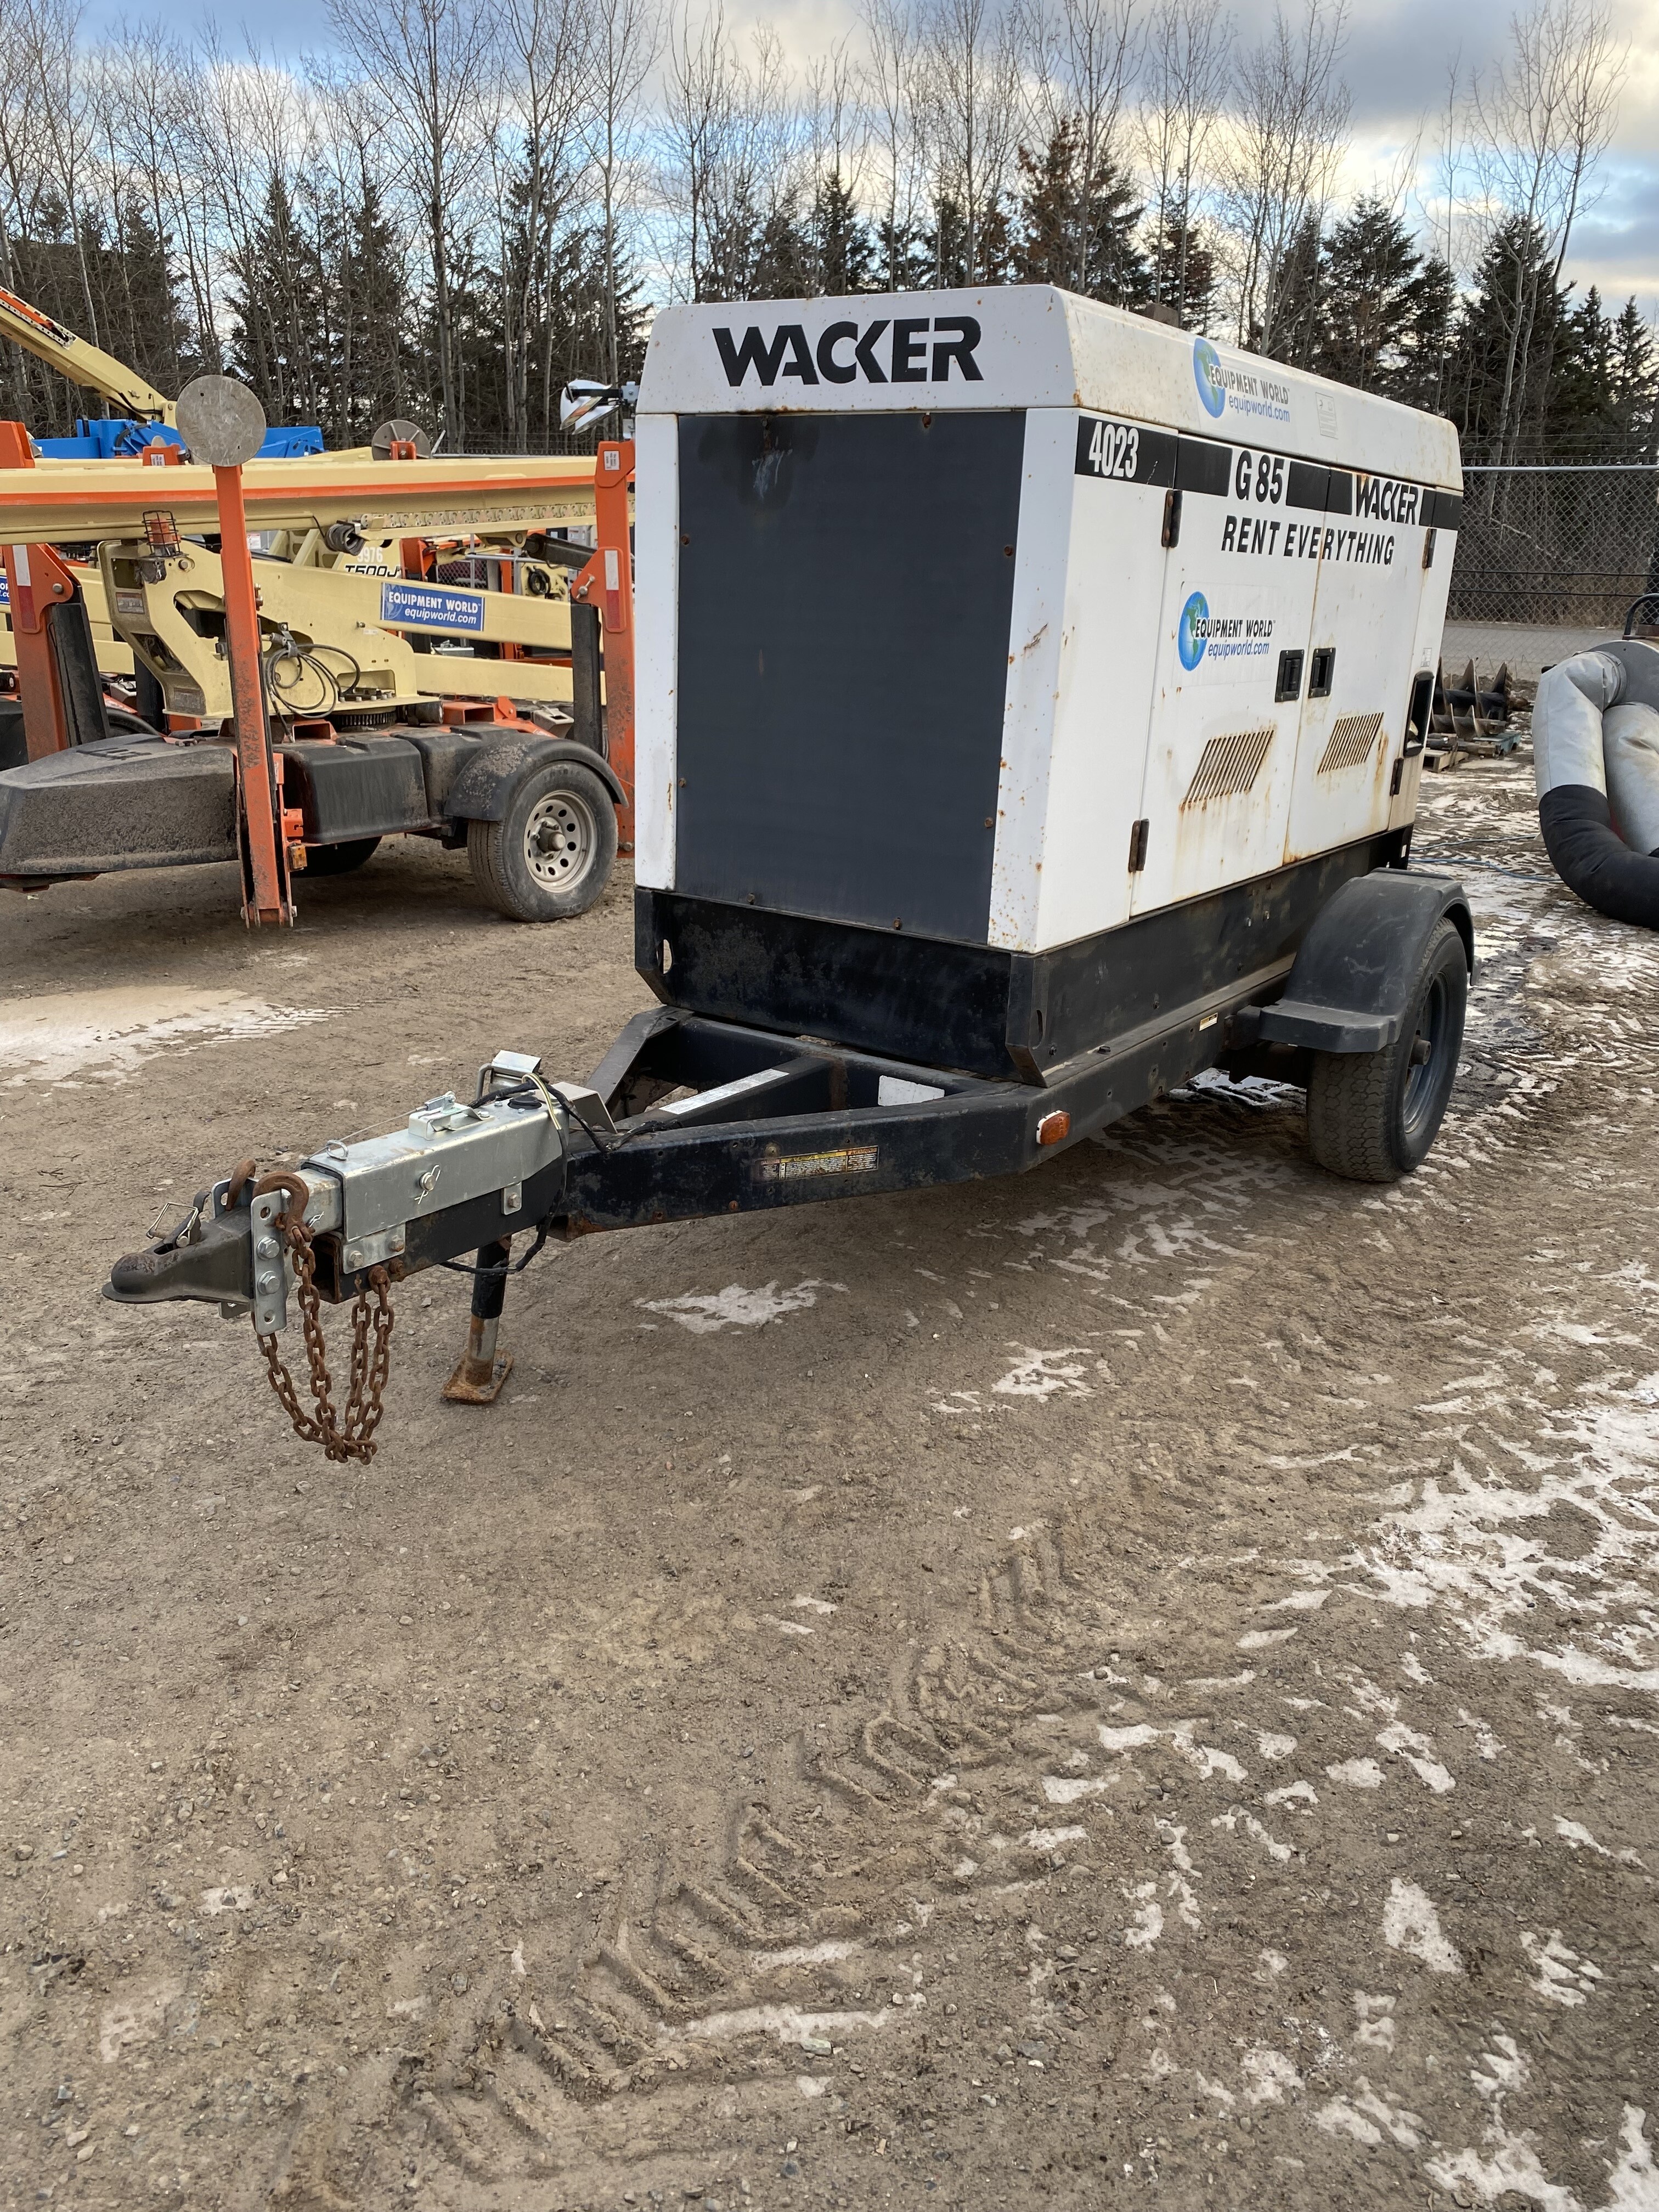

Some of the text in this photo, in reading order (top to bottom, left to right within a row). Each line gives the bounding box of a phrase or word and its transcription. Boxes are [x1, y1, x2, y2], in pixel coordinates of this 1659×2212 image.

[712, 316, 984, 387] WACKER
[1210, 365, 1289, 405] EQUIPMENT WORLD
[1228, 394, 1290, 422] equipworld.com
[1088, 421, 1139, 478] 4023
[1235, 450, 1285, 505] G 85
[1356, 474, 1419, 525] WACKER
[1221, 515, 1395, 566] RENT EVERYTHING
[388, 591, 478, 614] EQUIPMENT WORLD
[404, 607, 477, 625] equipworld.com
[1195, 619, 1273, 638] EQUIPMENT WORLD
[1208, 639, 1269, 661] equipworld.com
